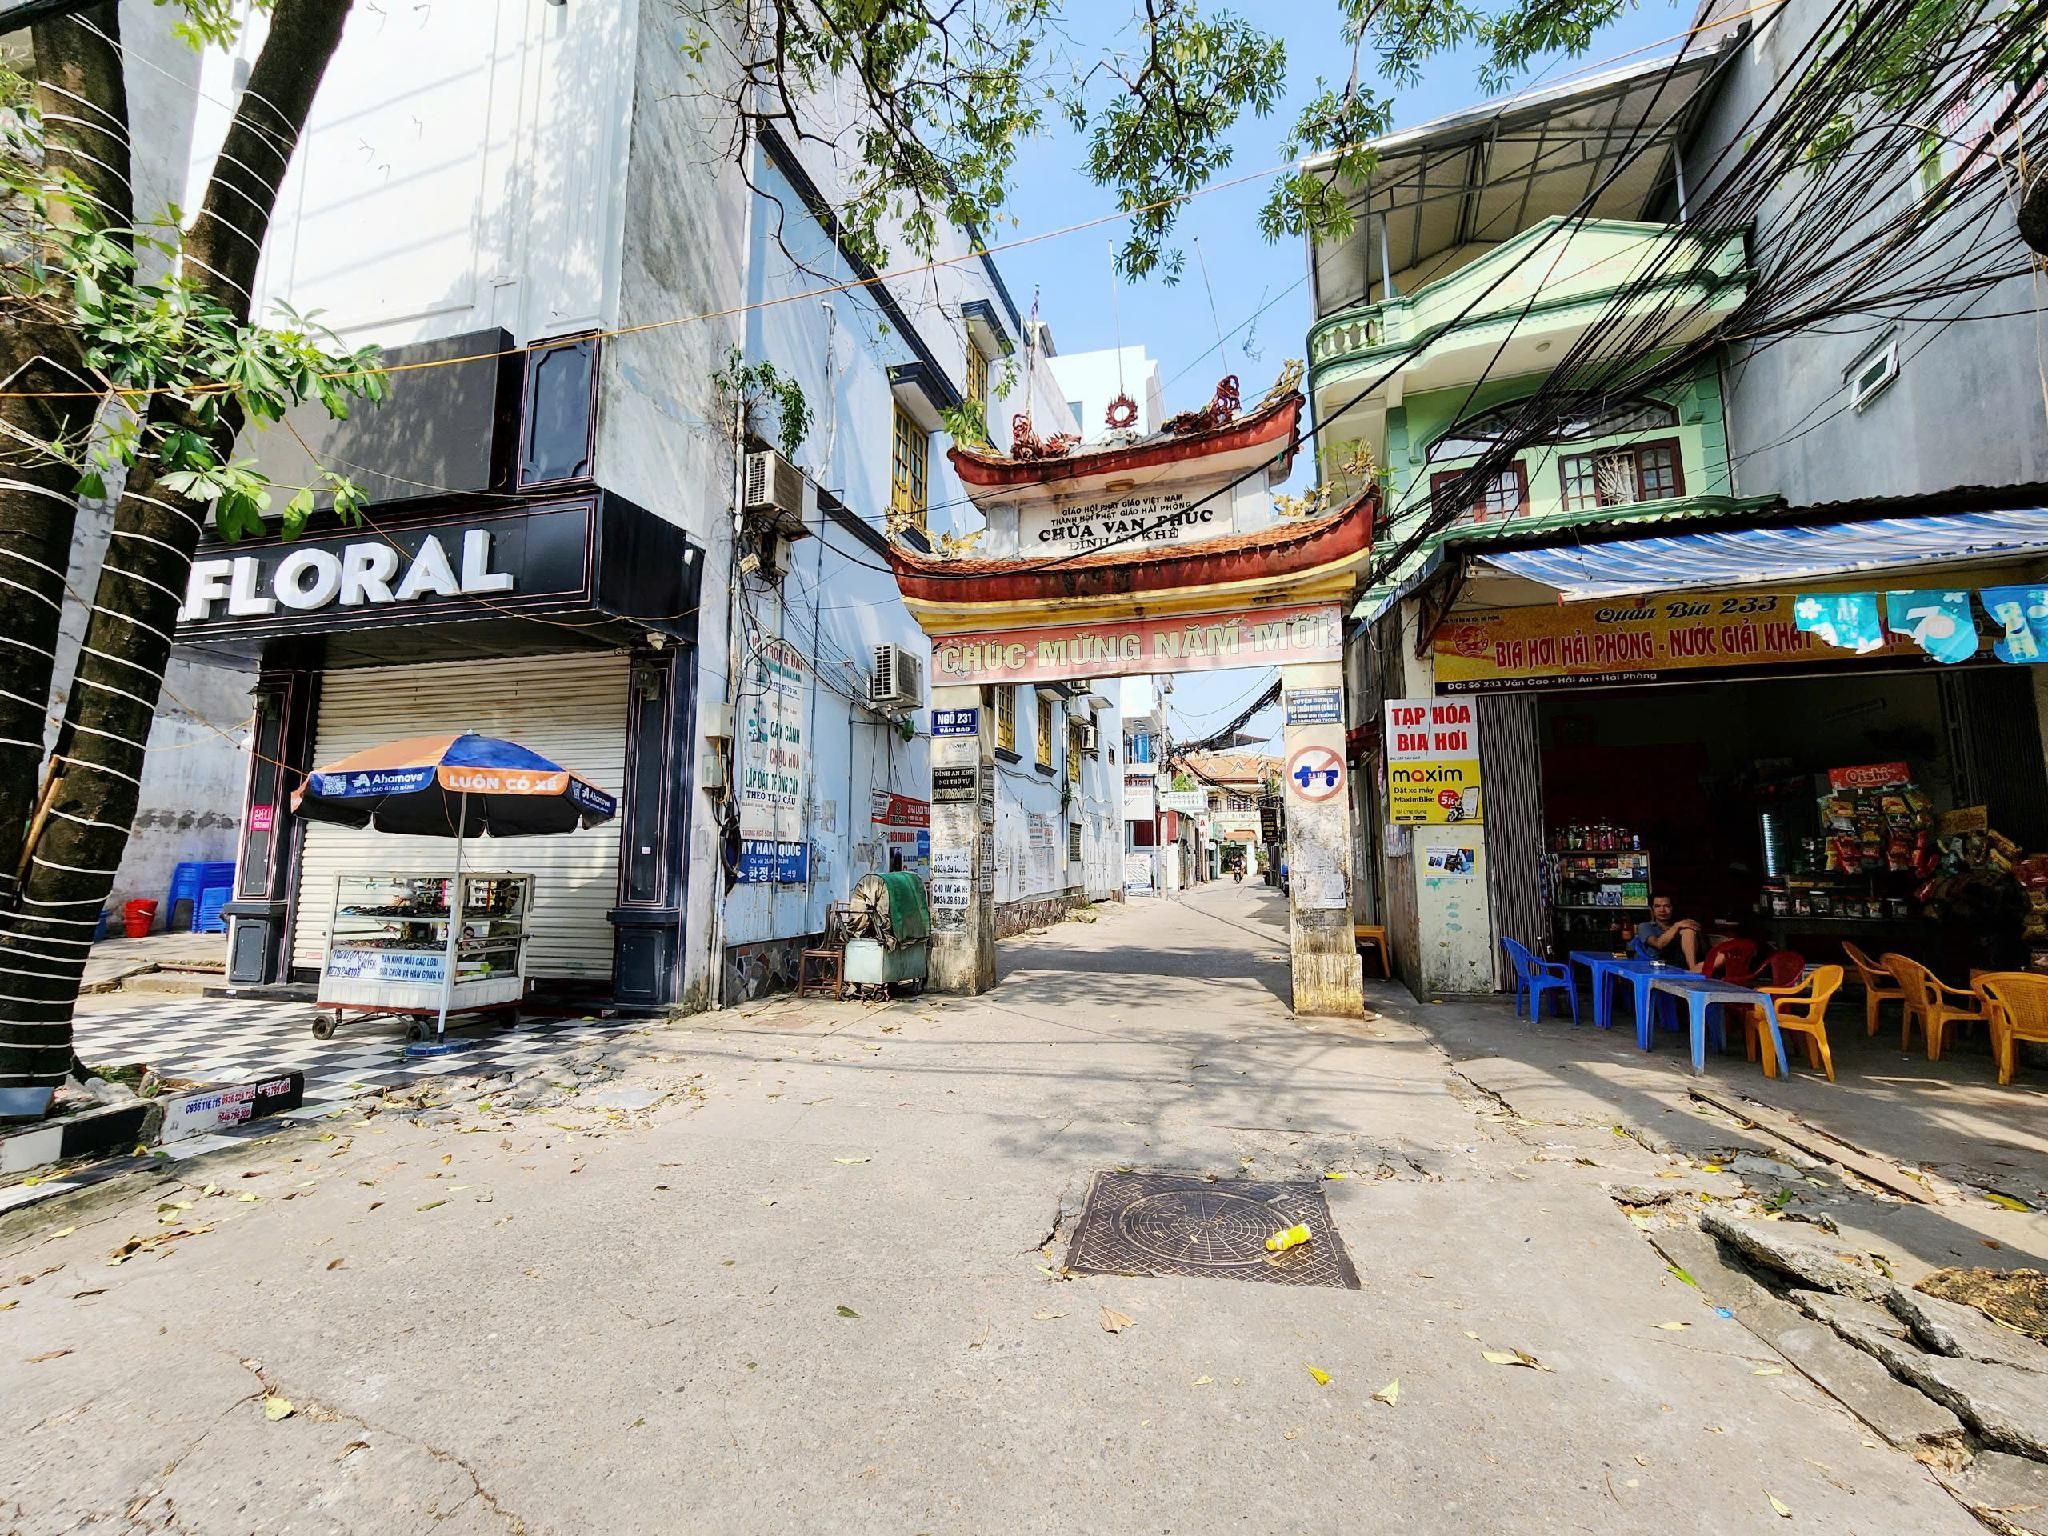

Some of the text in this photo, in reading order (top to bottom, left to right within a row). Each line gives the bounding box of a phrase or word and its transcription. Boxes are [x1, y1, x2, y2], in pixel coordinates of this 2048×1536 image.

[1062, 506, 1082, 516] GIÁO
[1121, 497, 1141, 508] GIÁO
[1164, 493, 1183, 503] NAM
[1120, 507, 1139, 517] GIÁO
[1038, 522, 1094, 542] CHÙA
[1102, 516, 1145, 535] VẠN
[1141, 526, 1179, 542] KHÊ
[184, 529, 514, 620] FLORAL
[1666, 601, 1711, 618] Bia
[1719, 597, 1777, 615] 233
[941, 638, 1026, 674] CHÚC
[1038, 632, 1142, 668] MỪNG
[1154, 624, 1241, 660] NĂM
[1495, 641, 1522, 669] BIA
[1527, 636, 1556, 669] HƠI
[1560, 630, 1590, 667] HẢI
[1593, 627, 1655, 665] PHÒNG
[1668, 621, 1718, 658] NƯỚC
[1720, 617, 1760, 656] GIẢI
[1527, 678, 1549, 686] Cao
[937, 712, 972, 725] NGÕ 231
[1391, 703, 1471, 729] TẠP HÓA
[1397, 729, 1468, 752] BIA HƠI
[372, 772, 424, 785] Ahamova
[1392, 765, 1462, 782] maxim
[1846, 767, 1890, 784] Oishi
[449, 774, 500, 789] LUÔN
[505, 775, 530, 791] CÓ
[1418, 786, 1434, 795] máy
[745, 790, 766, 800] THEO
